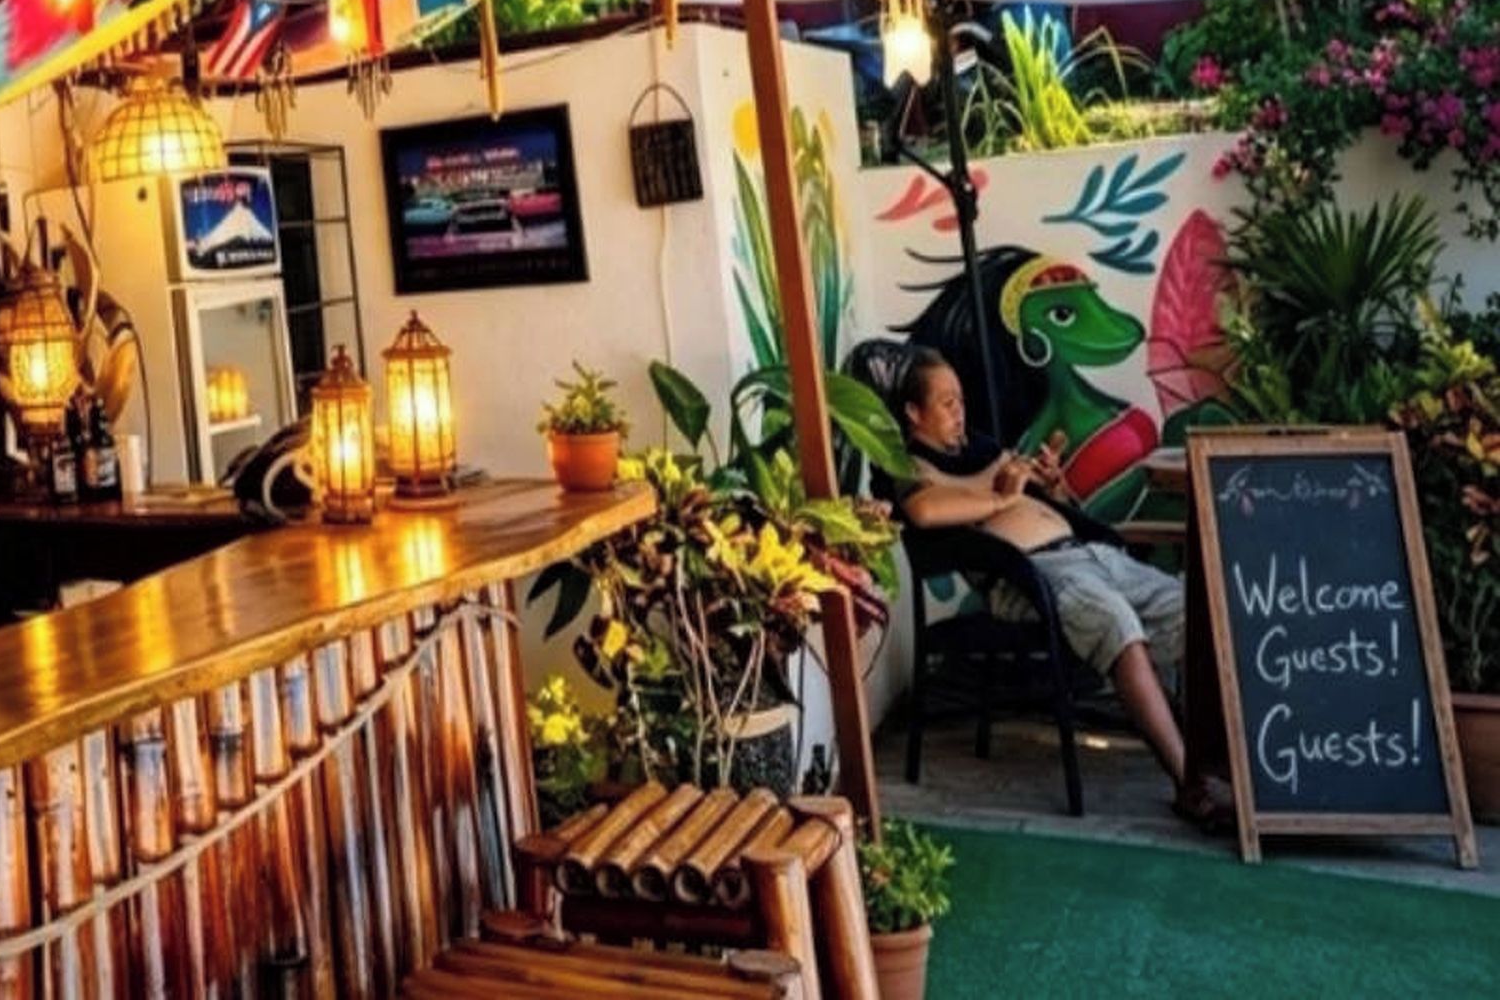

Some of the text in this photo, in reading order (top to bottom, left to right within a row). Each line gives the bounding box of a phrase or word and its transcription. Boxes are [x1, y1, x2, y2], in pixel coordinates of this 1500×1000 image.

[1232, 553, 1406, 618] Welcome
[1257, 621, 1399, 690] Guests!
[1258, 699, 1421, 794] Guests!
